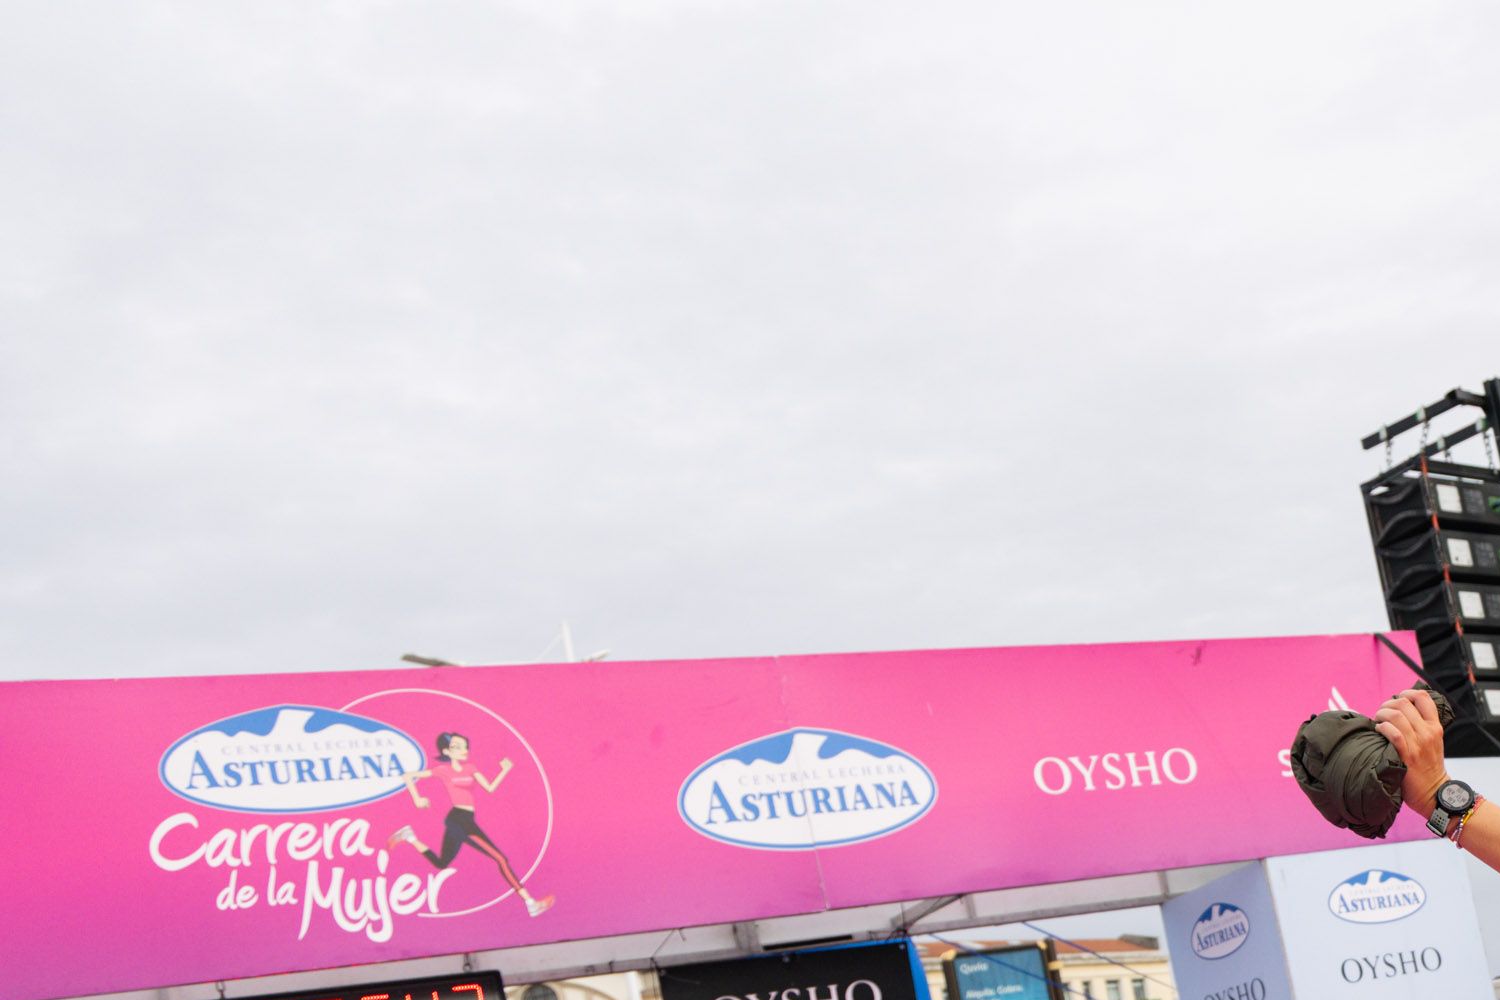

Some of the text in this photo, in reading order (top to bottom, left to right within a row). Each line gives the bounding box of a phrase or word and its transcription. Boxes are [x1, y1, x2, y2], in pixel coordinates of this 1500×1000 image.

[185, 747, 407, 791] ASTURIANA
[1033, 747, 1199, 796] OYSHO
[704, 779, 921, 825] ASTURIANA
[148, 812, 375, 872] Carrera
[216, 850, 458, 943] de la Mujer
[1337, 891, 1421, 914] ASTURIANA
[1341, 946, 1443, 984] OYSHO
